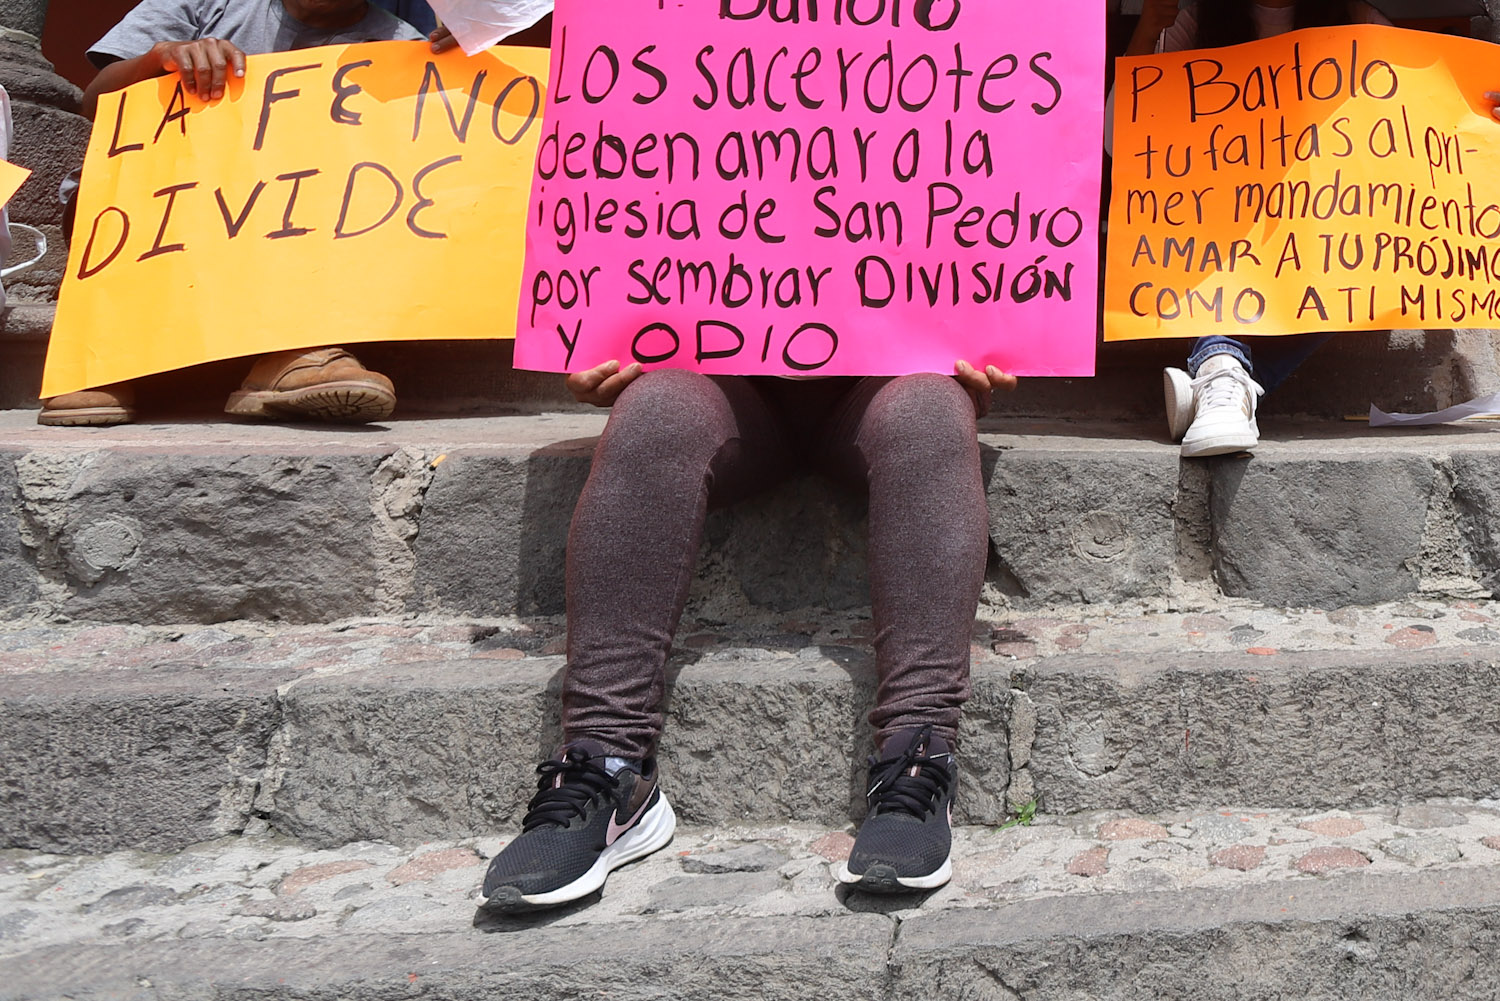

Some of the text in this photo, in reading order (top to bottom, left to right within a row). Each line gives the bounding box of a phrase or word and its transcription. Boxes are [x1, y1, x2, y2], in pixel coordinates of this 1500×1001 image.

[553, 25, 1063, 116] Los sacerdotes
[1182, 39, 1399, 123] Bartolo
[107, 59, 541, 159] LA FE NO
[1134, 104, 1479, 189] tu faltas al pri-
[537, 119, 994, 185] deben amar a la
[77, 154, 462, 280] DIVIDE
[537, 181, 1084, 254] iglesia de San Pedro
[1127, 183, 1214, 226] mer
[531, 252, 1073, 329] por sembrar DIVISIÓN
[1131, 234, 1261, 273] AMAR
[1274, 232, 1301, 279] A
[1319, 232, 1364, 273] TU
[1129, 281, 1266, 325] COMO
[1296, 286, 1329, 321] A
[1338, 286, 1376, 323] TI
[631, 320, 839, 371] ODIO
